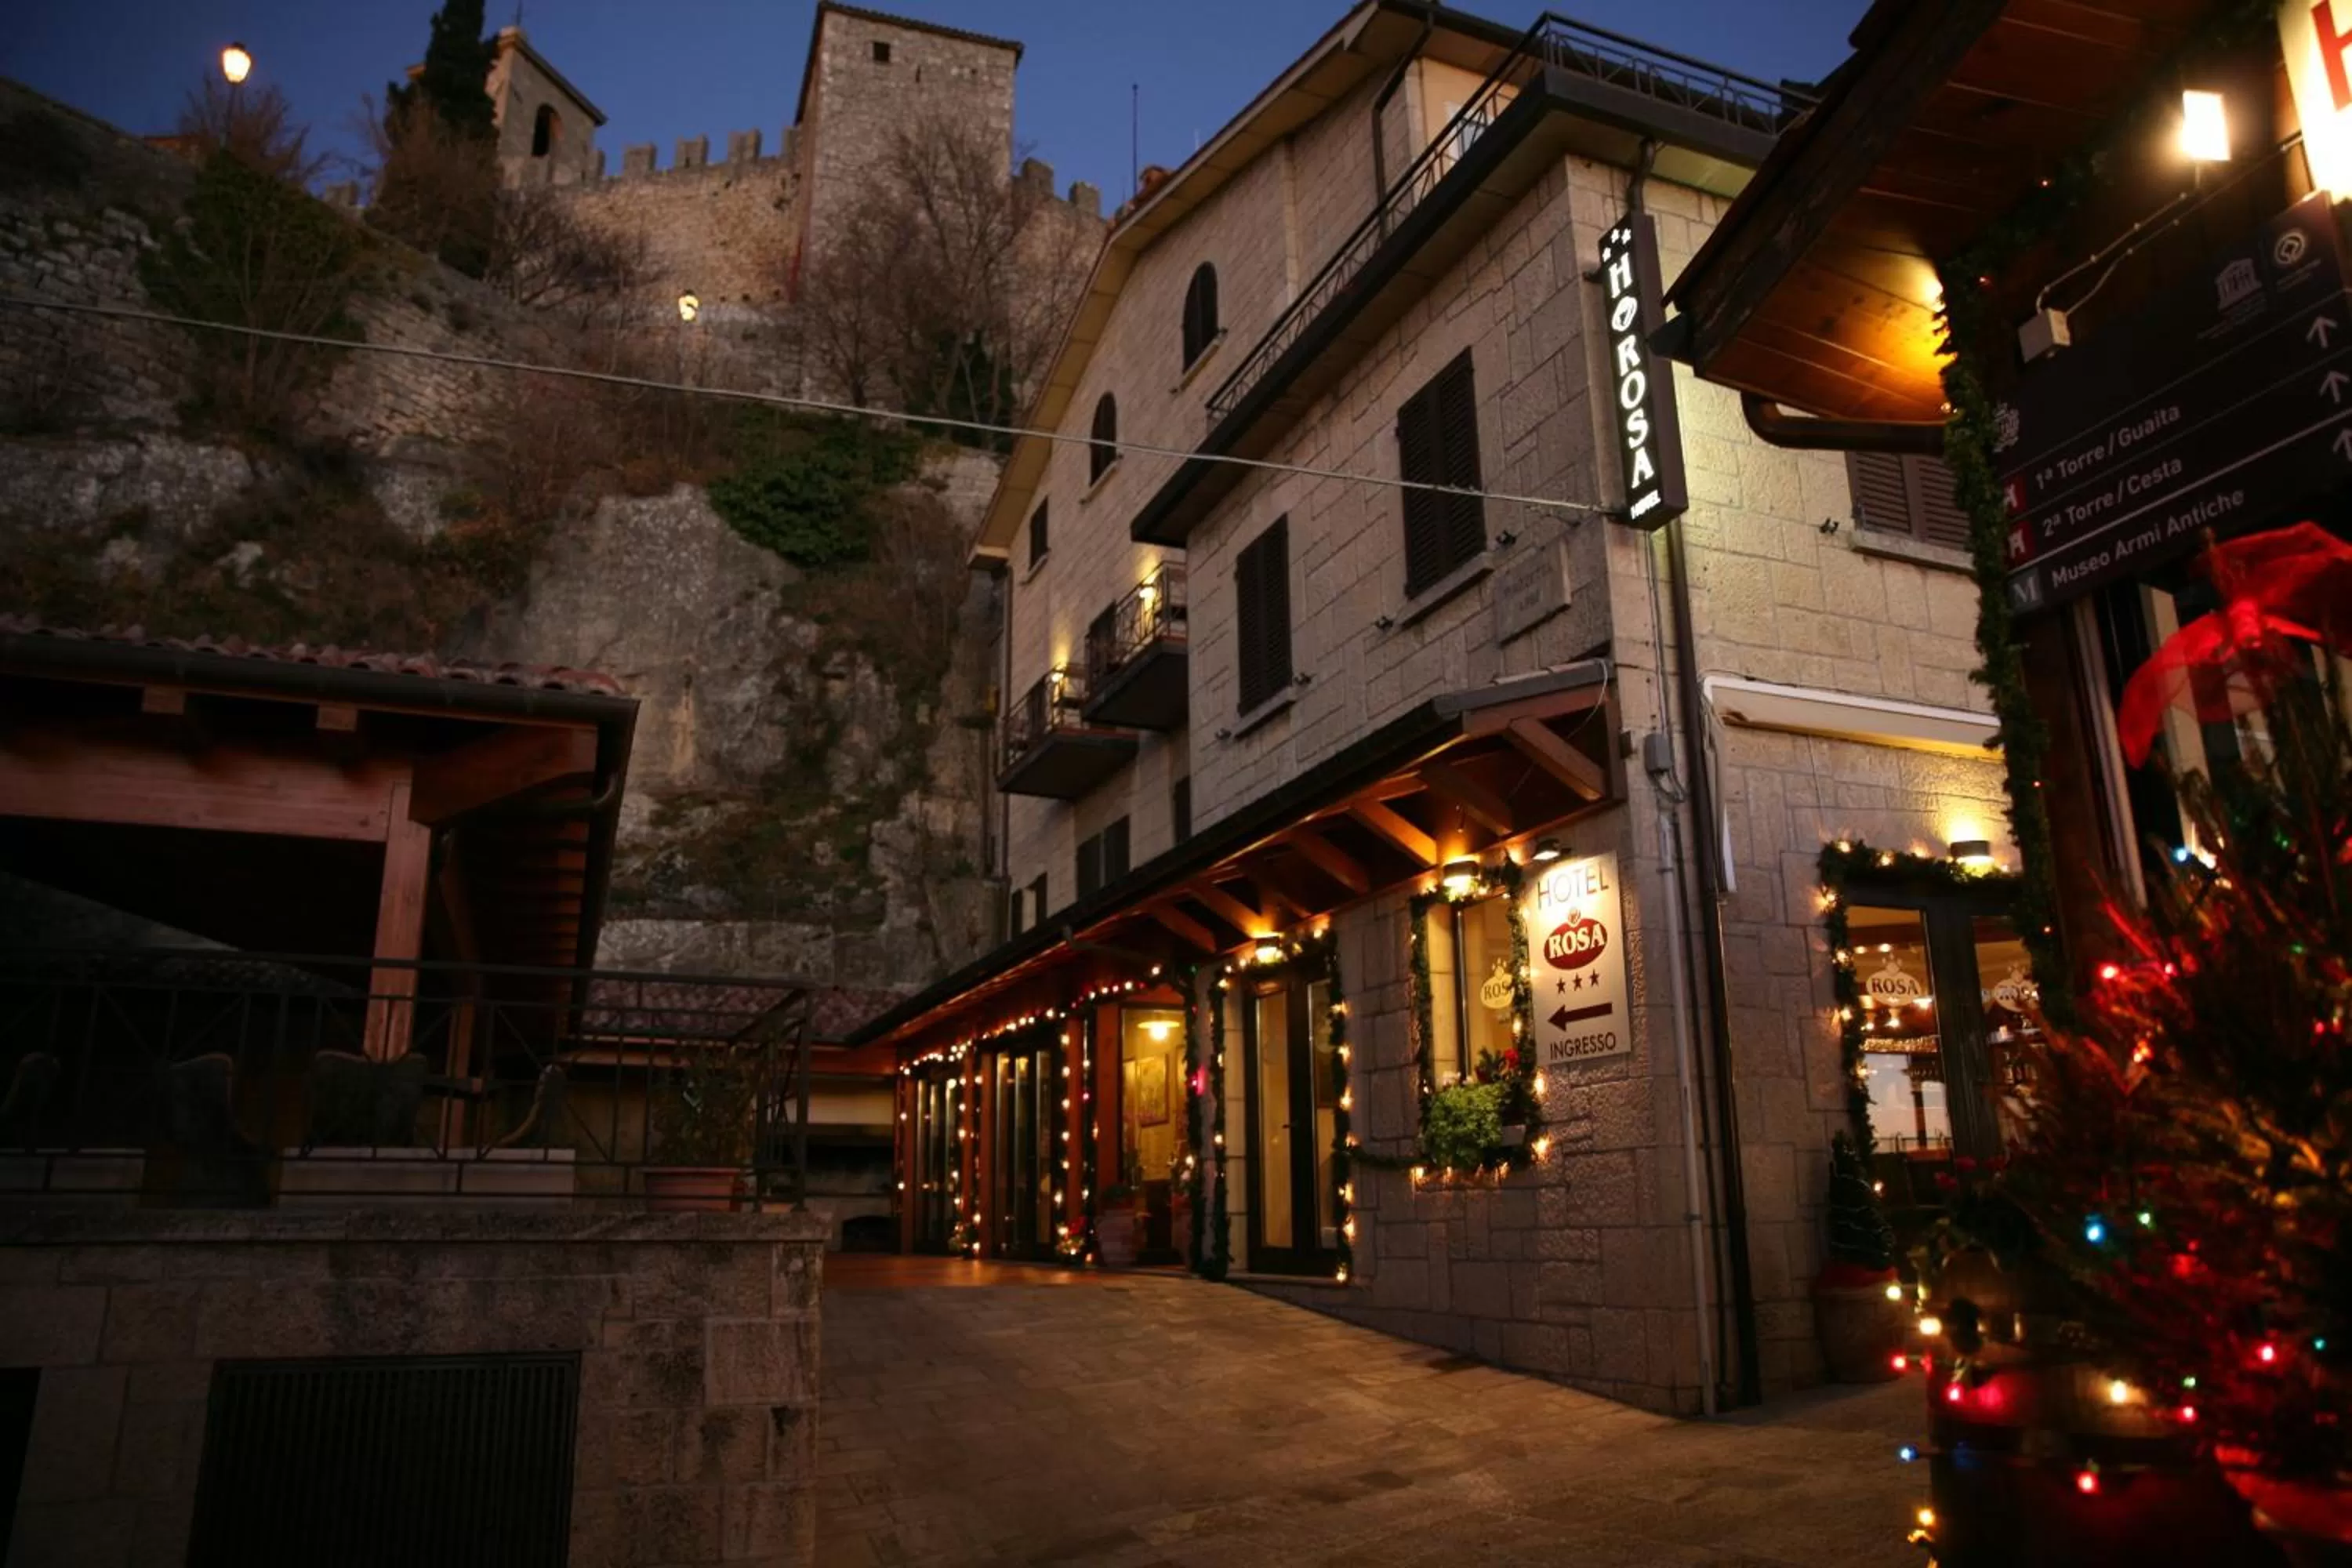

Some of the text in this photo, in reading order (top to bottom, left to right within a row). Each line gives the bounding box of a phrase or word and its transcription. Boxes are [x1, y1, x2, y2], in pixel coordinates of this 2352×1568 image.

[2057, 445, 2106, 478] Torre
[2118, 405, 2182, 448] Guaita
[2065, 492, 2115, 526] Torre
[2126, 458, 2183, 495] Cesta
[2051, 550, 2111, 589] Museo
[2115, 523, 2161, 561] Armi
[2166, 489, 2245, 537] Antiche
[1537, 861, 1610, 910] HOTEL
[1548, 923, 1606, 959] ROSA
[1483, 981, 1513, 1000] ROS
[1871, 978, 1919, 996] ROSA
[1550, 1032, 1616, 1060] INGRESSO
